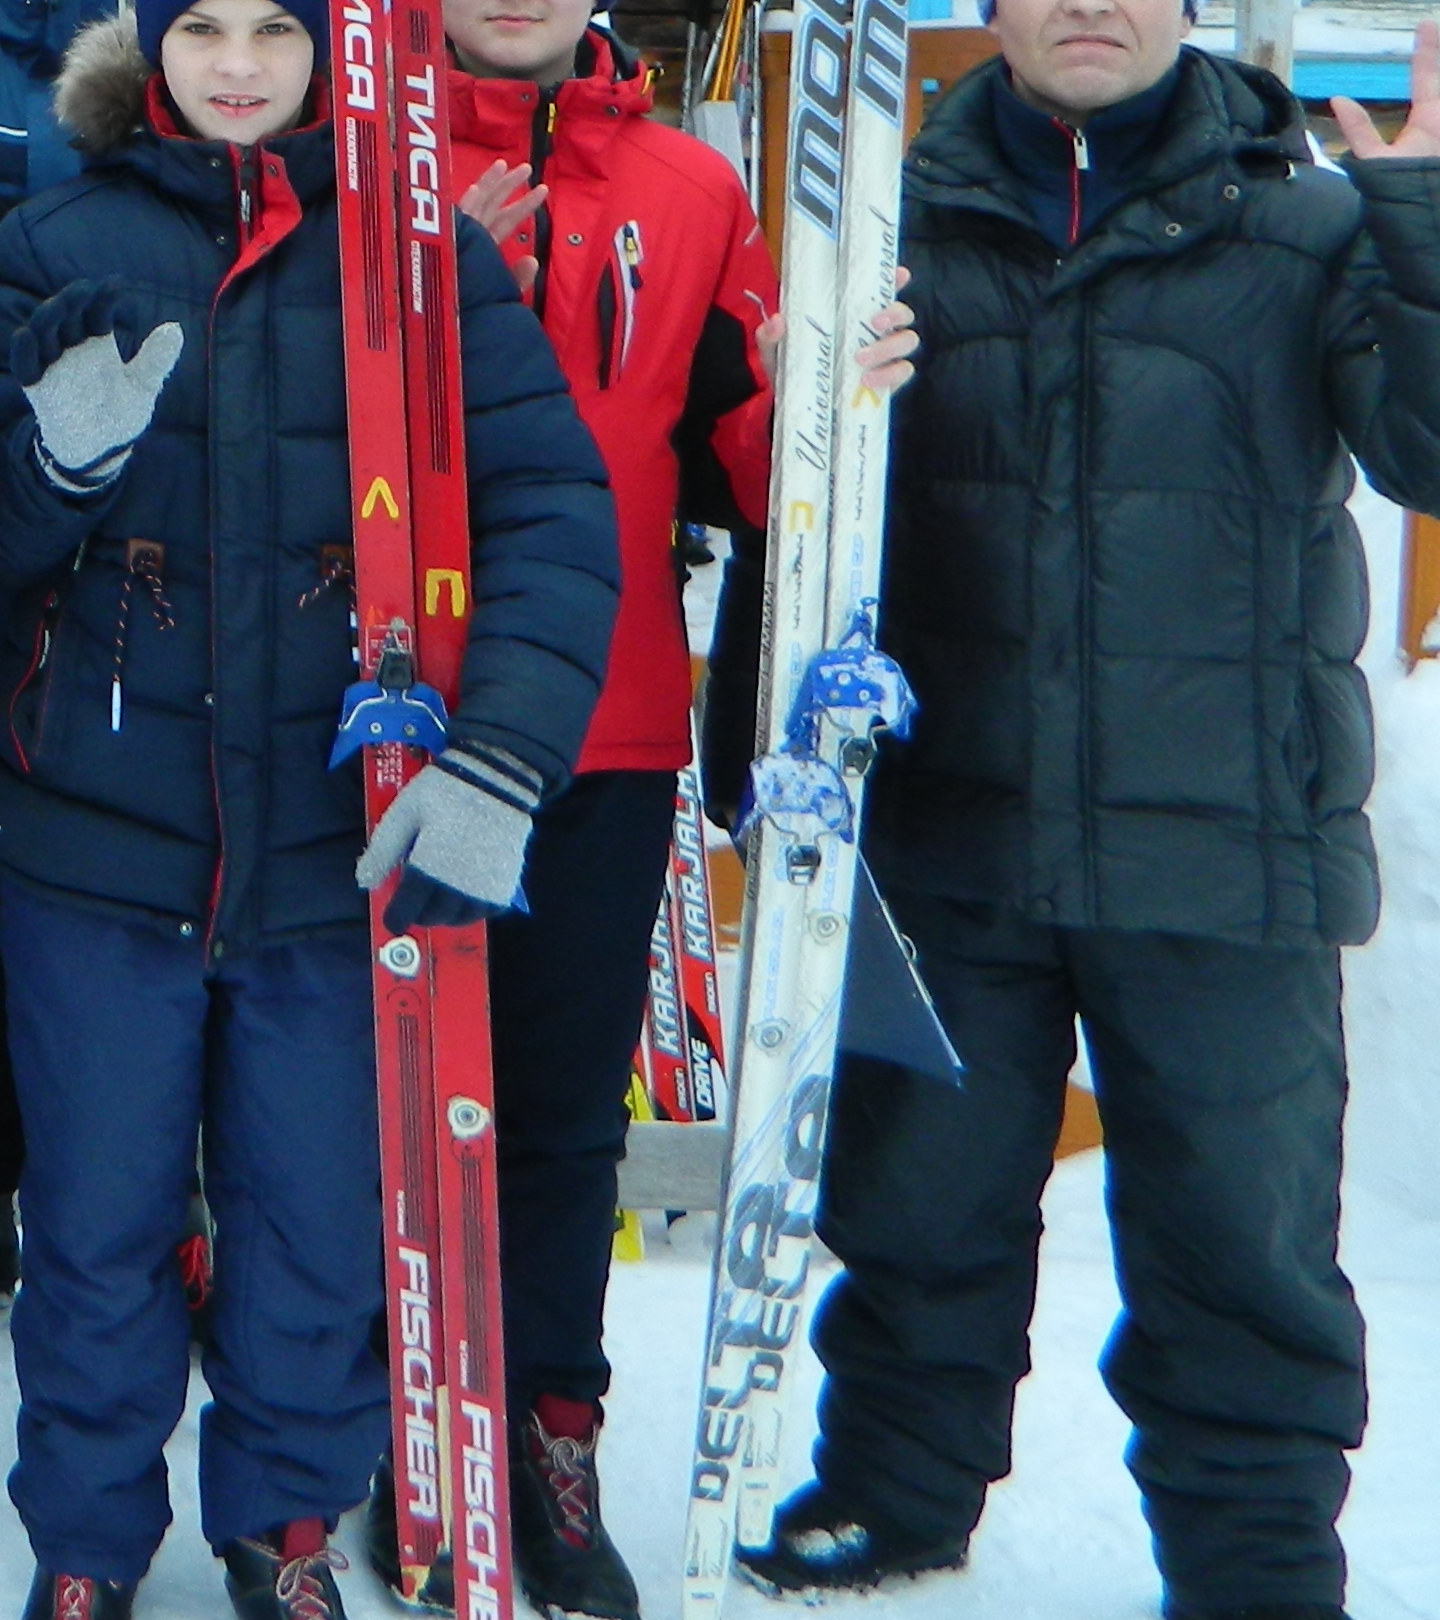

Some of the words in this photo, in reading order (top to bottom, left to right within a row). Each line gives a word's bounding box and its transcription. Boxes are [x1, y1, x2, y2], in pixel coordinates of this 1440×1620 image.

[405, 63, 440, 234] ТИСА
[795, 314, 832, 471] Universal
[690, 1037, 713, 1109] DRIVE
[691, 1182, 770, 1501] DELTA
[747, 1074, 829, 1392] DELTA
[398, 1245, 438, 1520] FISCHER
